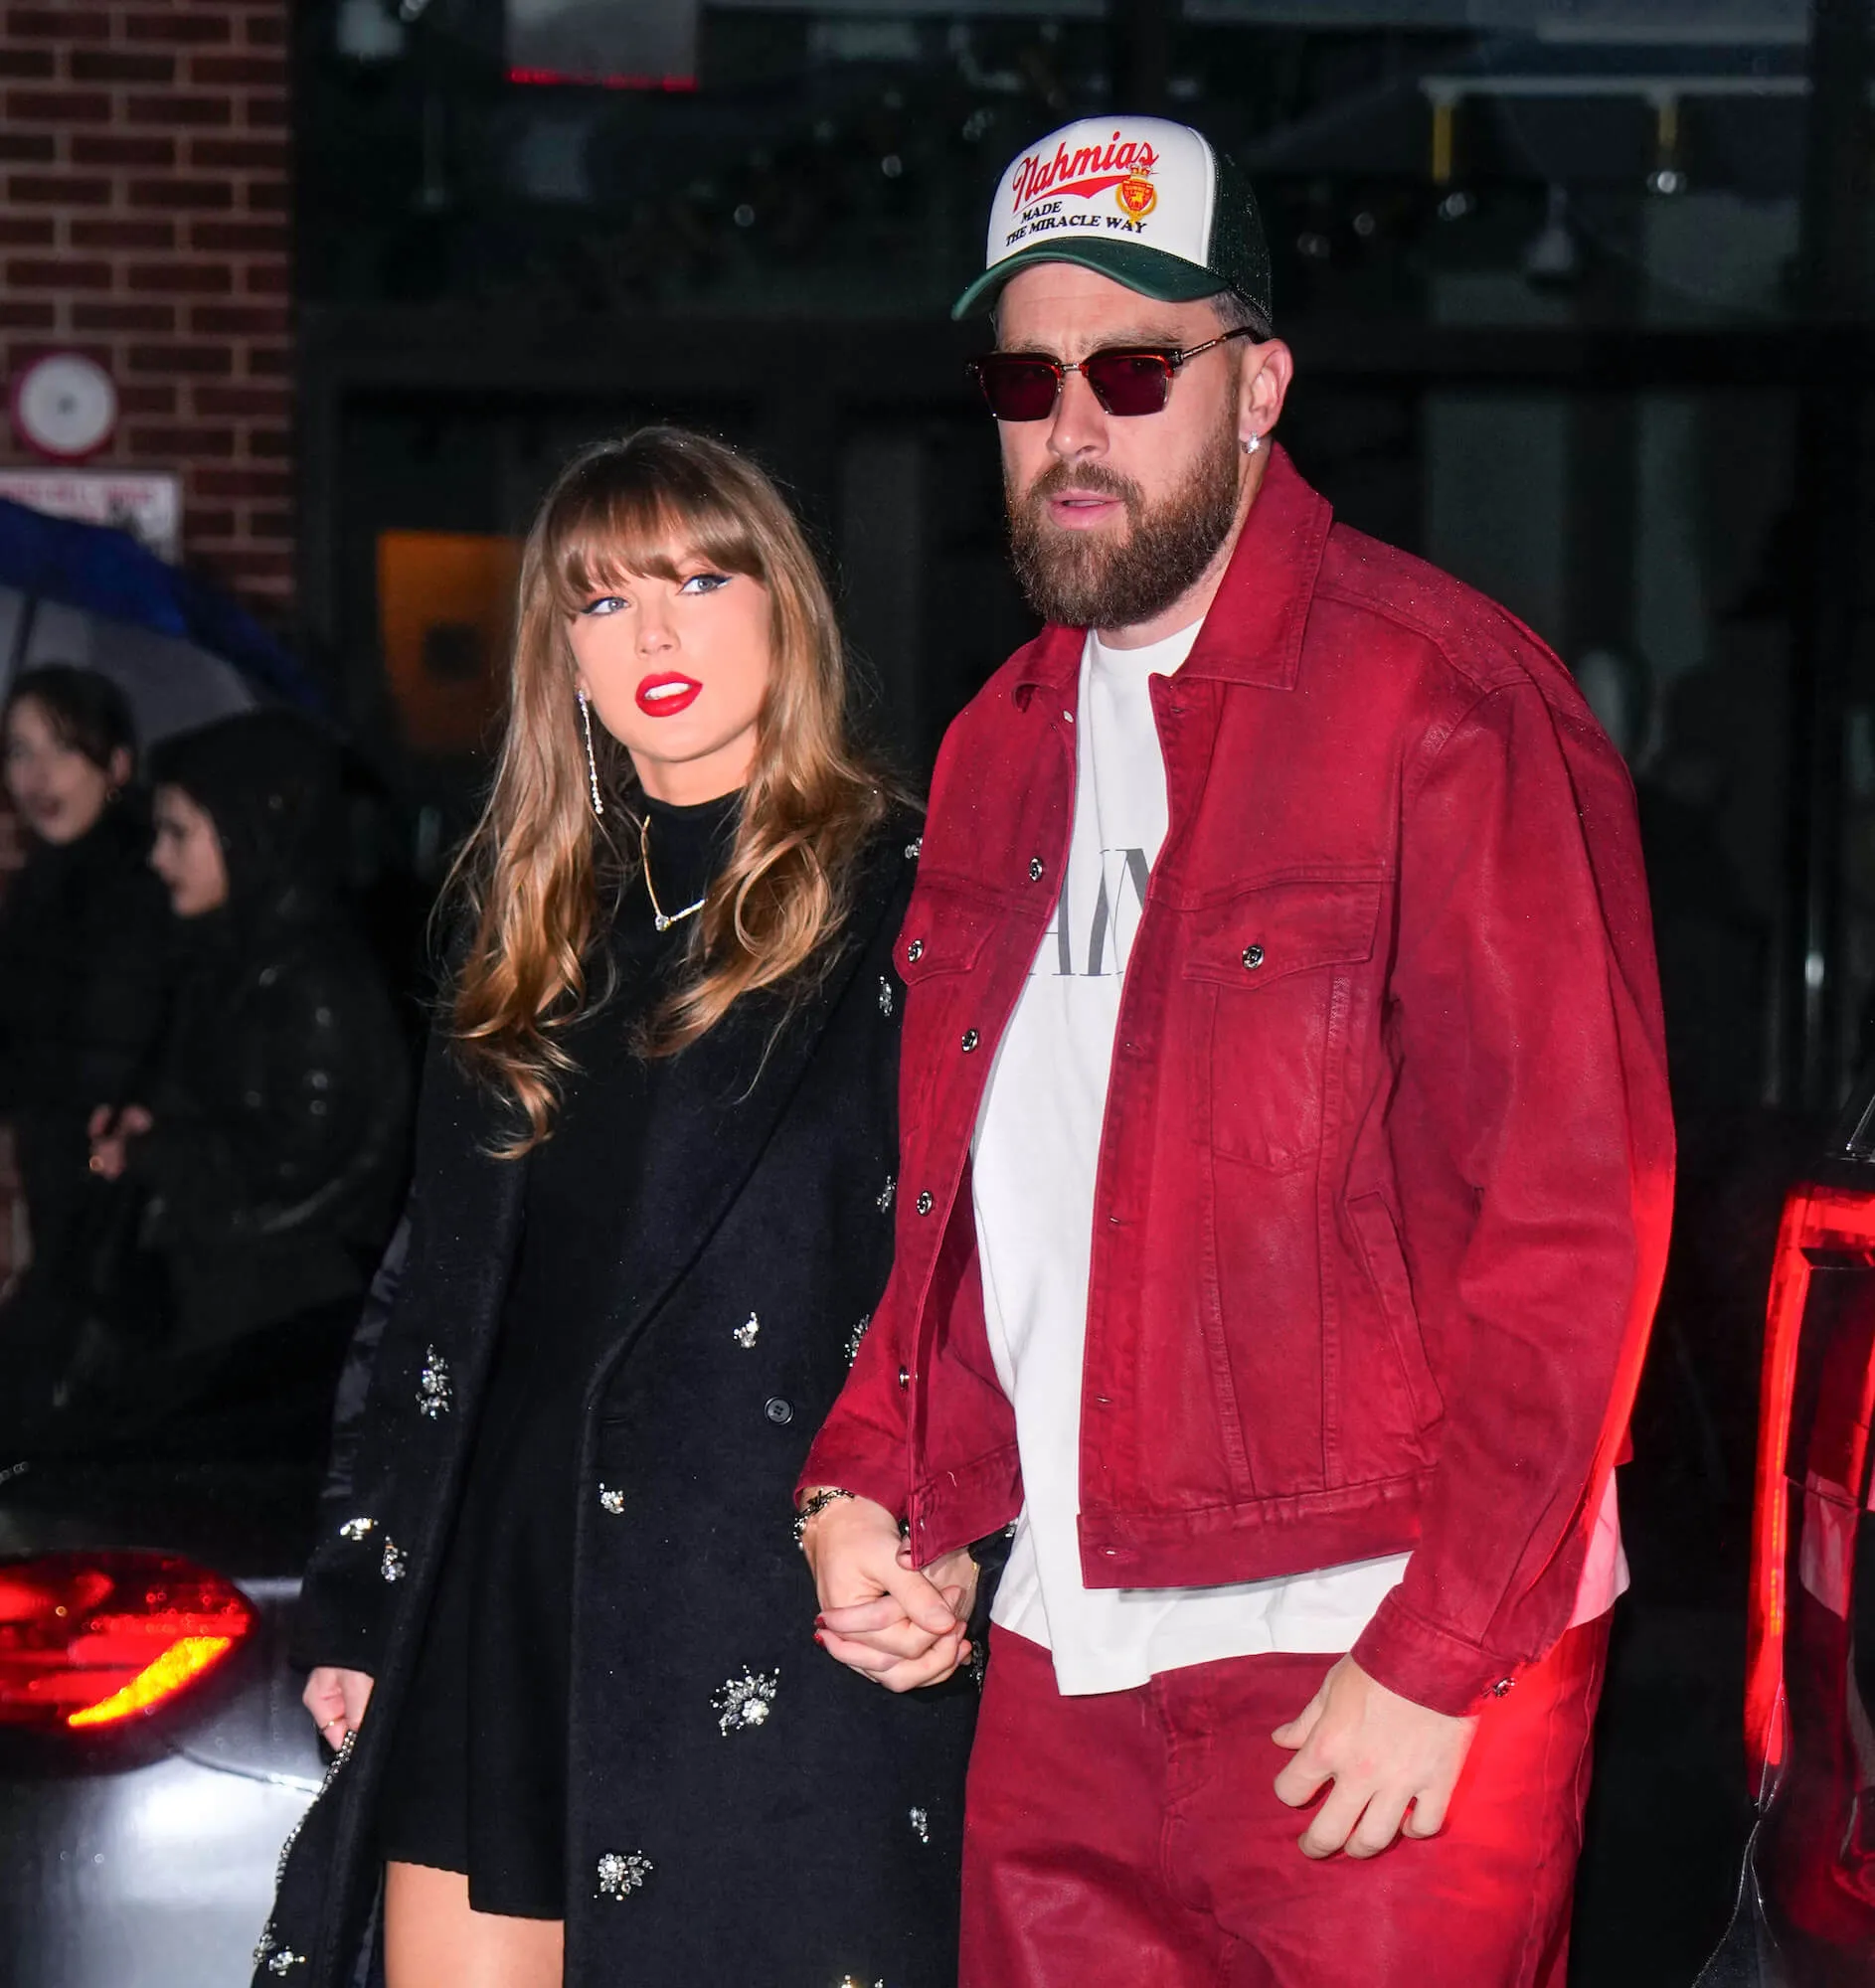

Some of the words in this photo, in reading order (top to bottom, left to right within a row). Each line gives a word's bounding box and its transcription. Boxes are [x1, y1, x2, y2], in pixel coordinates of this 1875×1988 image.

[1012, 130, 1160, 213] Nahmias
[1020, 201, 1063, 224] MADE
[1005, 225, 1027, 248] THE
[1028, 215, 1102, 235] MIRACLE
[1106, 216, 1147, 234] WAY
